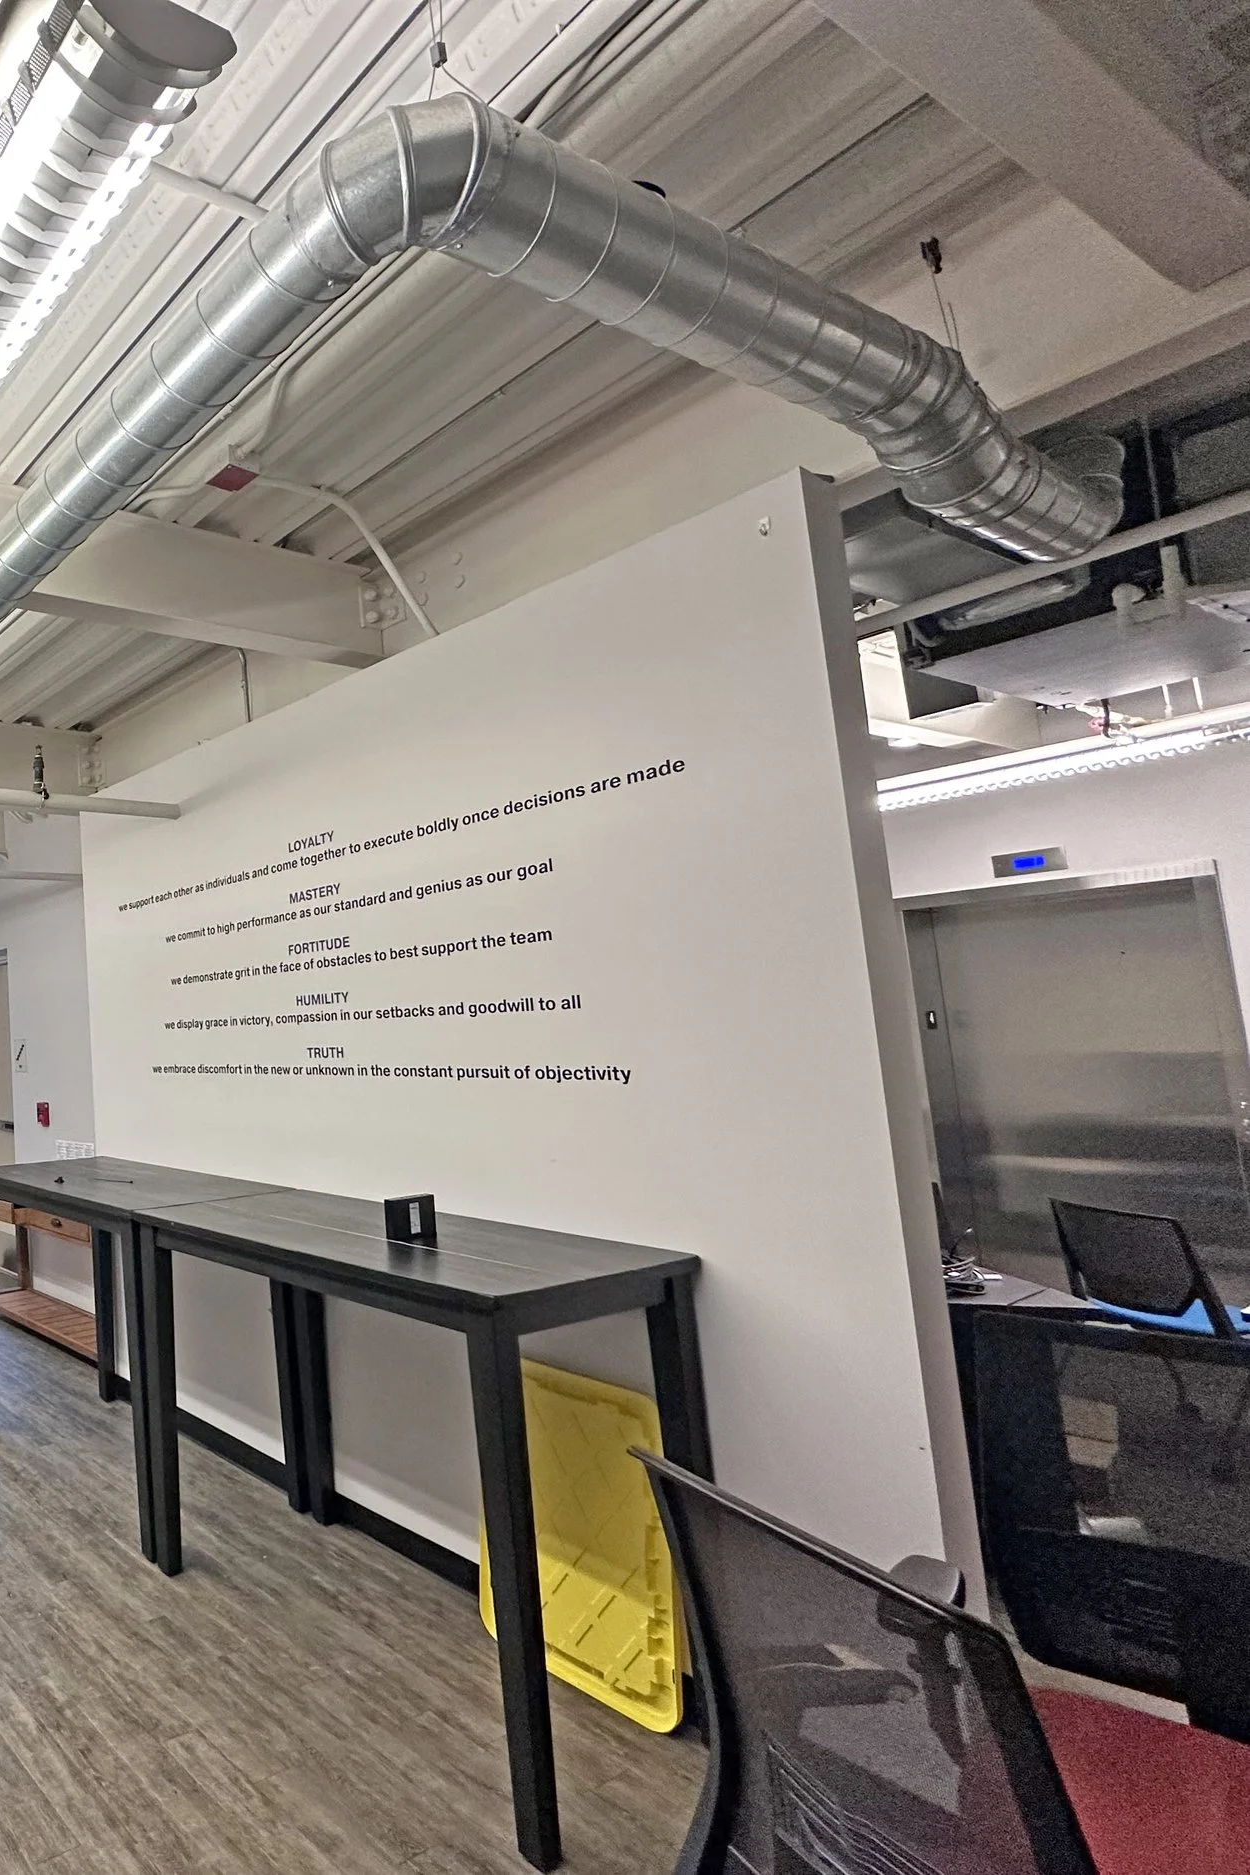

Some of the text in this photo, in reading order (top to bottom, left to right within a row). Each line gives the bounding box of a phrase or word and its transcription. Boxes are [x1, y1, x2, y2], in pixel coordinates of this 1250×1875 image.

[118, 759, 686, 913] we support each other as individuals and come together to execute boldly once decisions are made
[287, 830, 335, 853] LOYALTY
[165, 857, 554, 944] we commit to high performance as our standard and genius as our goal
[289, 882, 341, 905] MASTERY
[287, 935, 351, 956] FORTITUDE
[170, 929, 553, 986] we demonstrate grit in the face of obstacles to best support the team
[295, 991, 349, 1007] HUMILITY
[164, 994, 582, 1031] we display grace in victory, compassion in our setbacks and goodwill to all
[306, 1046, 345, 1059] TRUTH
[151, 1063, 632, 1085] we embrace discomfort in the new or unknown in the constant pursuit of objectivity
